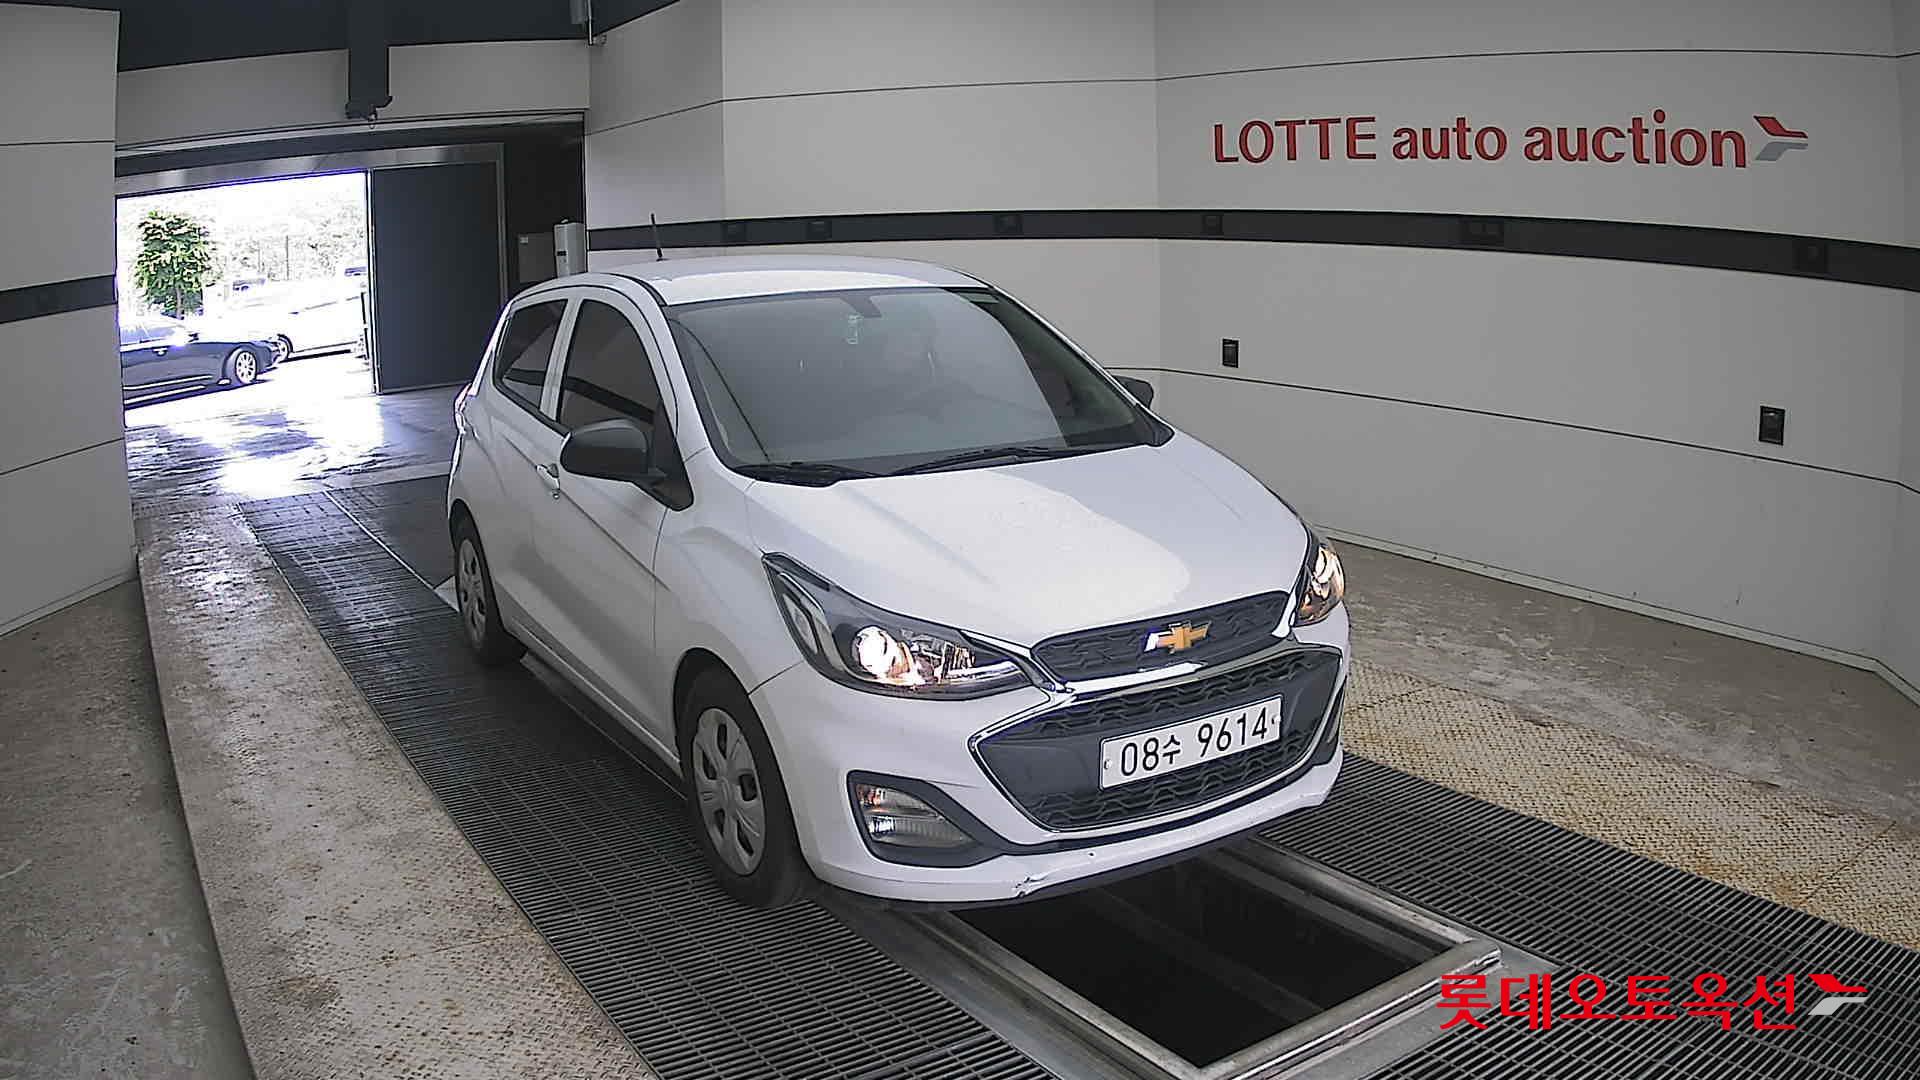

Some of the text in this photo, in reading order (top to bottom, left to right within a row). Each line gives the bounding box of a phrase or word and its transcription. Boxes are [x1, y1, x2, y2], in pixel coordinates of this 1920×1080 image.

[1213, 109, 1747, 168] LOTTE auto auction
[1120, 706, 1268, 777] 08수 9614
